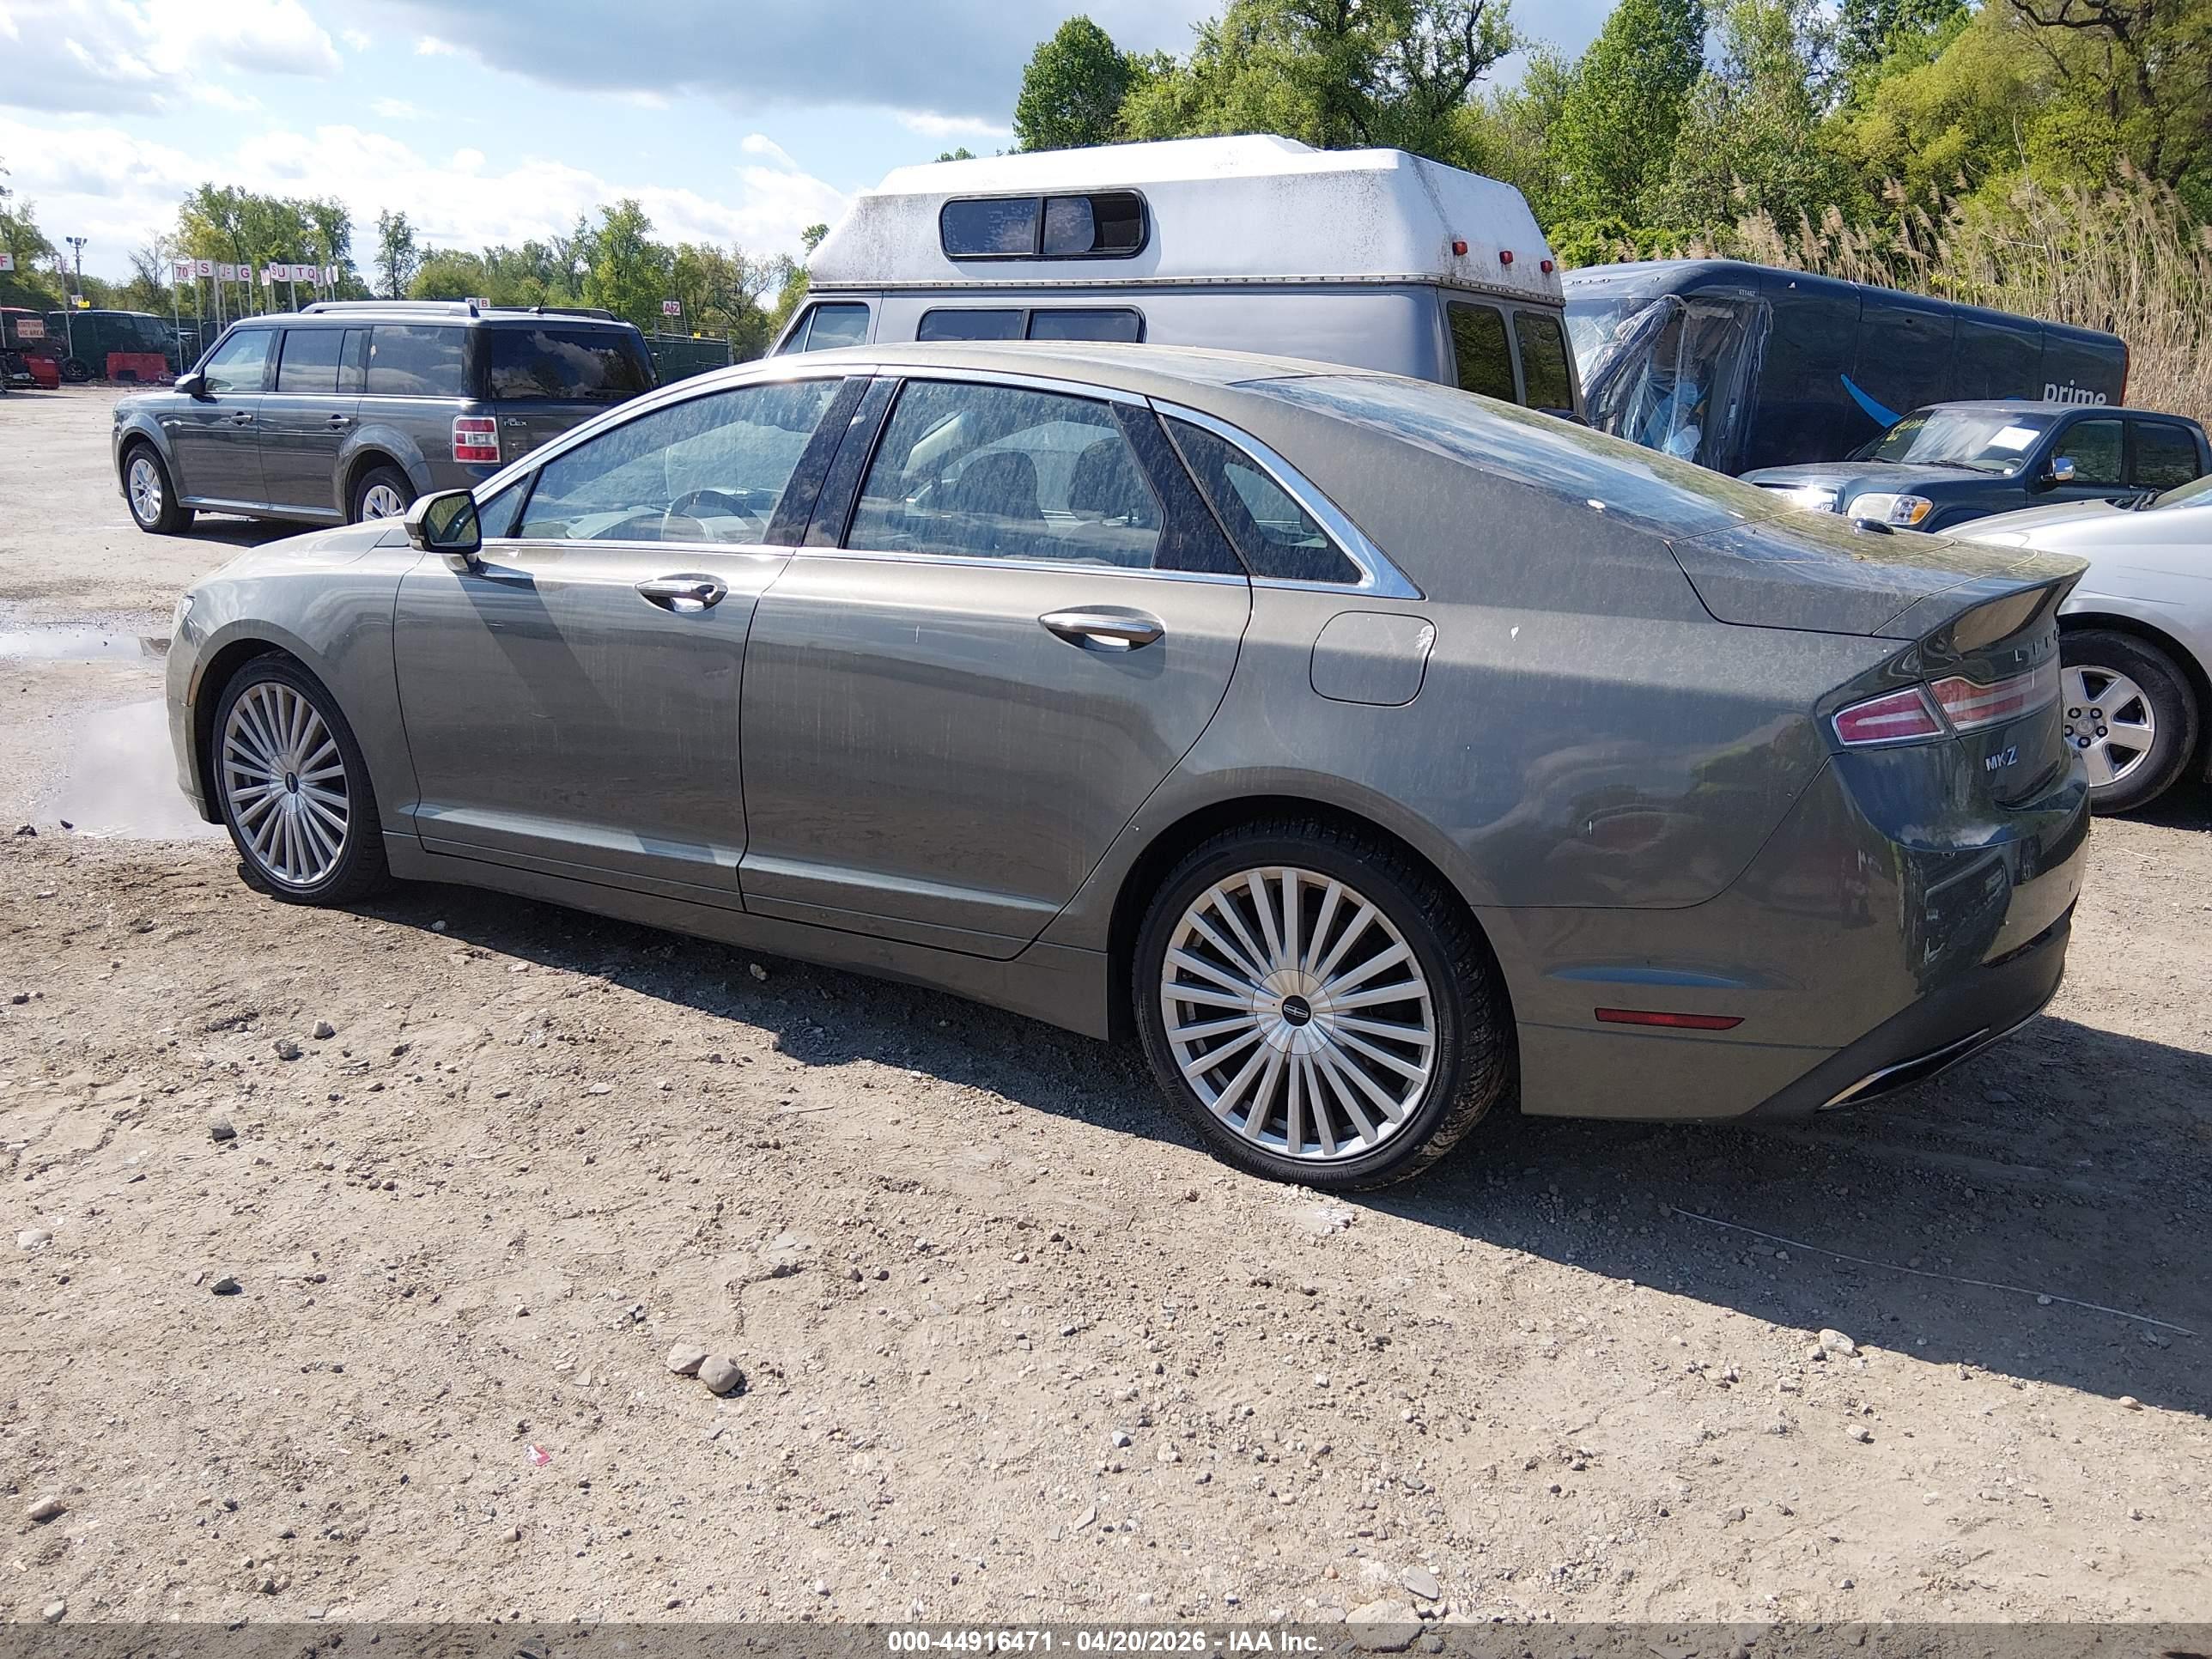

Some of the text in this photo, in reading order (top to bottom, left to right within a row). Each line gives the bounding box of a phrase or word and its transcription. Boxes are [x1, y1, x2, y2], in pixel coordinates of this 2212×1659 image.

[201, 263, 210, 274] S
[240, 268, 250, 278] G
[296, 267, 304, 277] T
[2043, 379, 2107, 405] prime
[1985, 744, 2018, 772] MKZ
